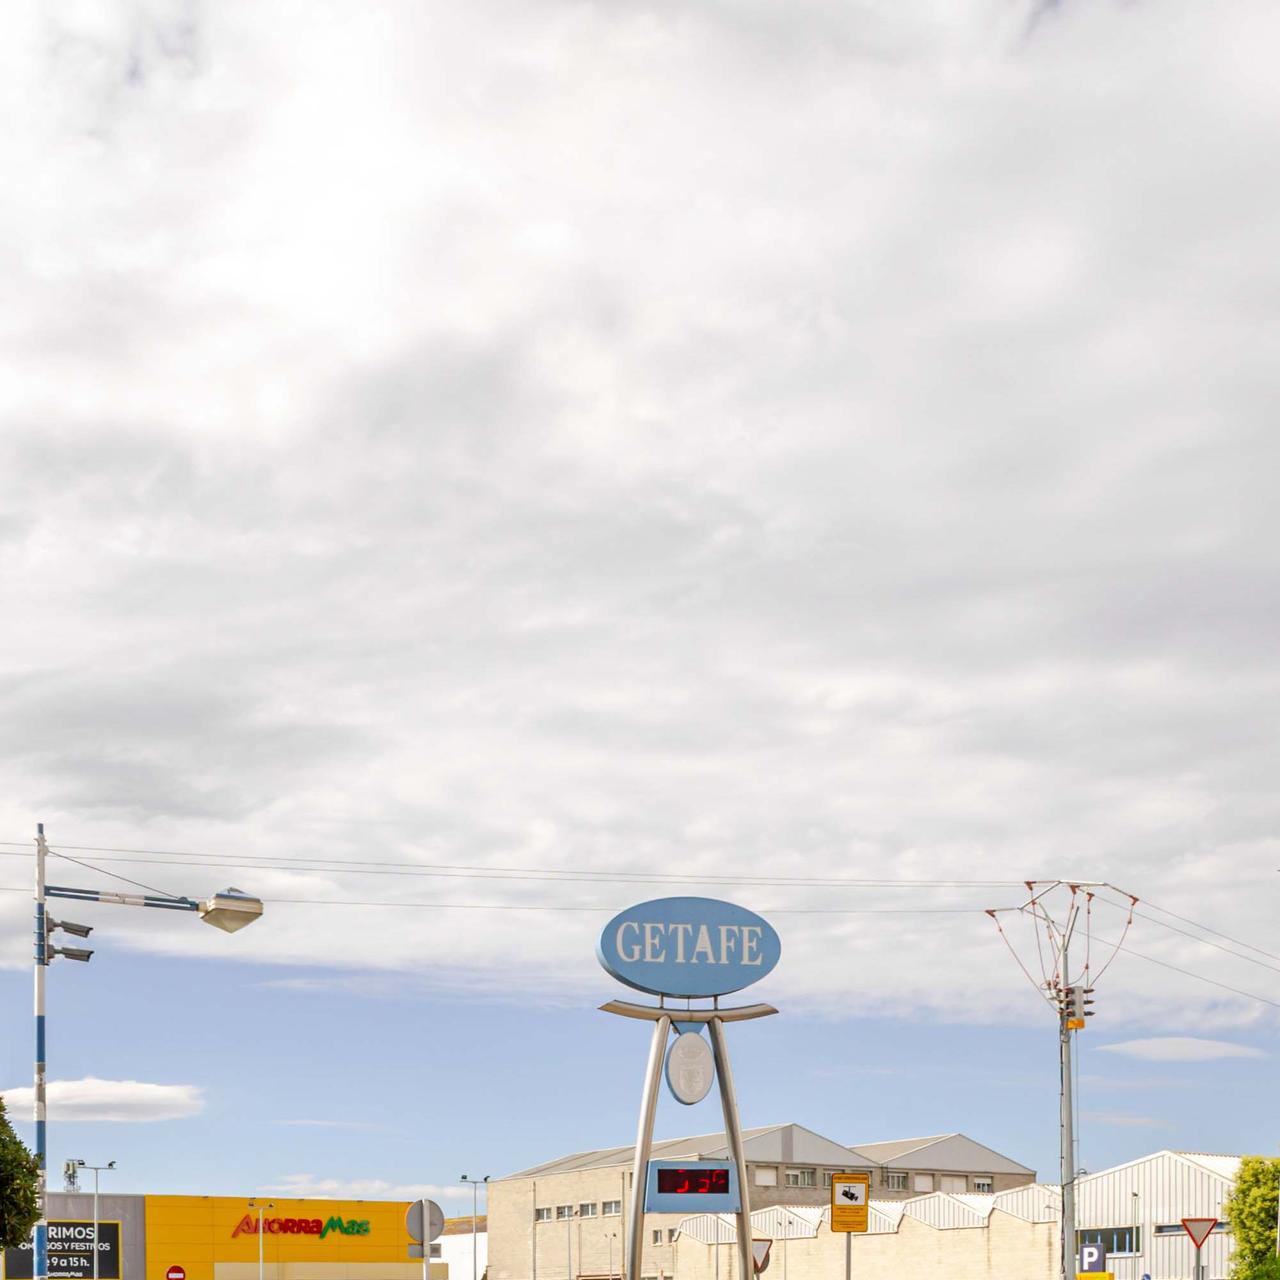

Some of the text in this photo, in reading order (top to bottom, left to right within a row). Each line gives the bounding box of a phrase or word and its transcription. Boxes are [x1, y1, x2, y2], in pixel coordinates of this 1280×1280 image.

[615, 922, 763, 966] GETAFE
[64, 1242, 71, 1250] Y
[51, 1257, 58, 1266] 9
[60, 1259, 67, 1267] a
[68, 1257, 79, 1267] 15
[1083, 1247, 1098, 1270] P
